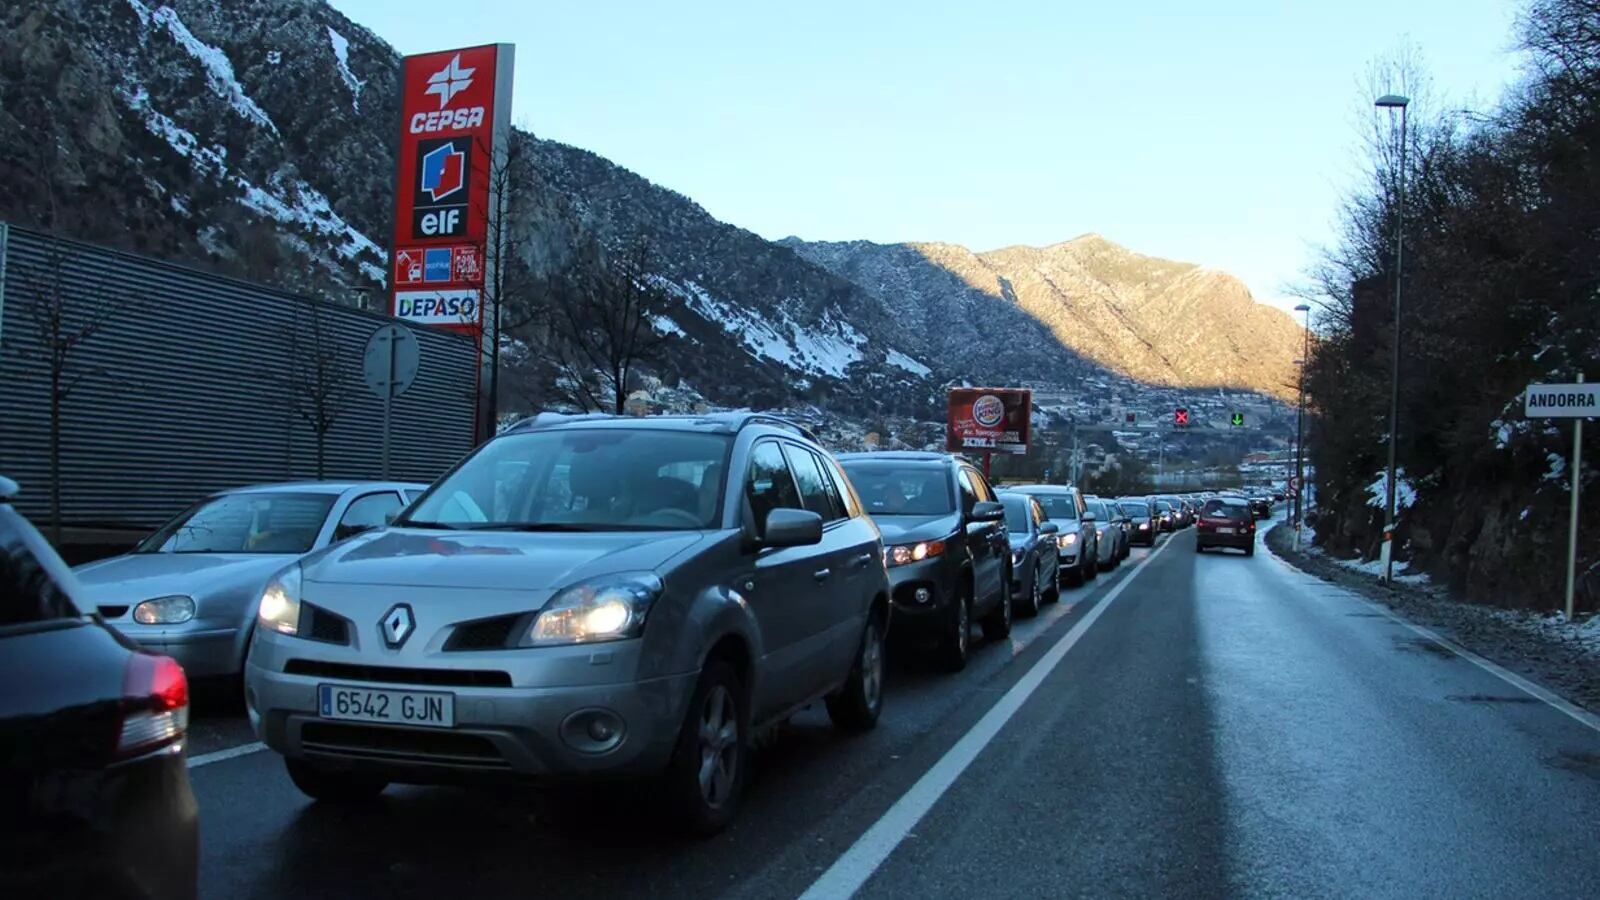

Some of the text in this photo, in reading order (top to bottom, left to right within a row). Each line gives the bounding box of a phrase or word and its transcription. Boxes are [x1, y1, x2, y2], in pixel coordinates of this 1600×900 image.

[410, 106, 485, 134] CEPSA
[421, 210, 460, 235] elf
[398, 296, 475, 317] DEPASO
[1529, 393, 1596, 408] ANDORRA
[337, 690, 442, 721] 6542 GJN
